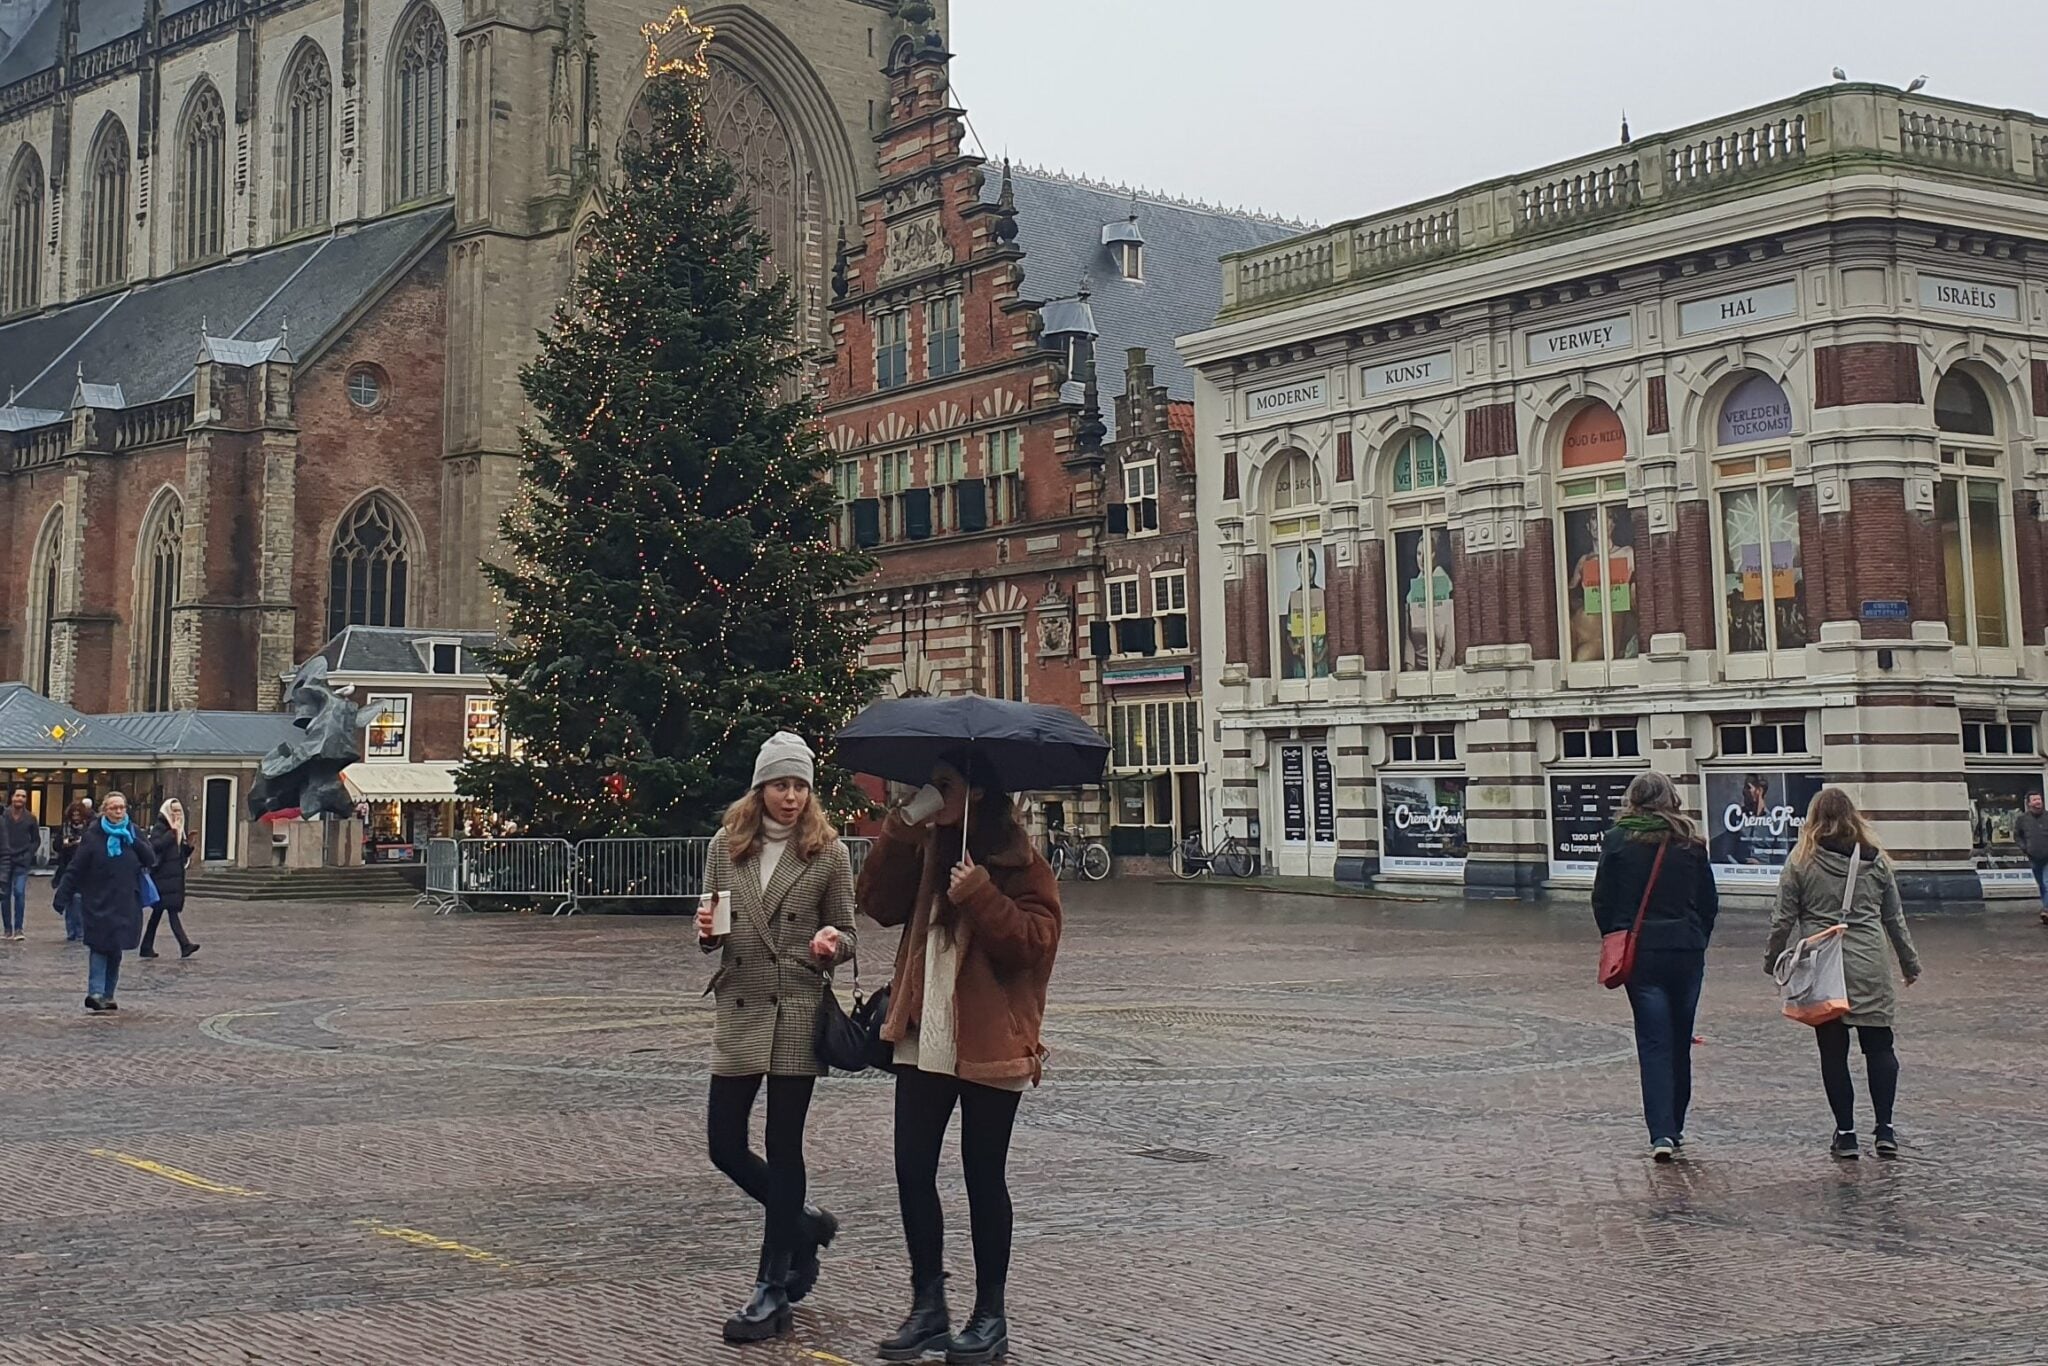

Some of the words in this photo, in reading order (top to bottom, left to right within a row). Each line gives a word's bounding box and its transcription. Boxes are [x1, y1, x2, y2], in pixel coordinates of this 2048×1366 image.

[1720, 297, 1757, 319] HAL
[1937, 285, 1996, 309] ISRAËLS
[1548, 326, 1613, 352] VERWEY
[1385, 362, 1432, 385] KUNST
[1256, 385, 1320, 411] MODERNE
[1725, 403, 1780, 423] VERLEDEN
[1731, 416, 1789, 437] TOEKOMST
